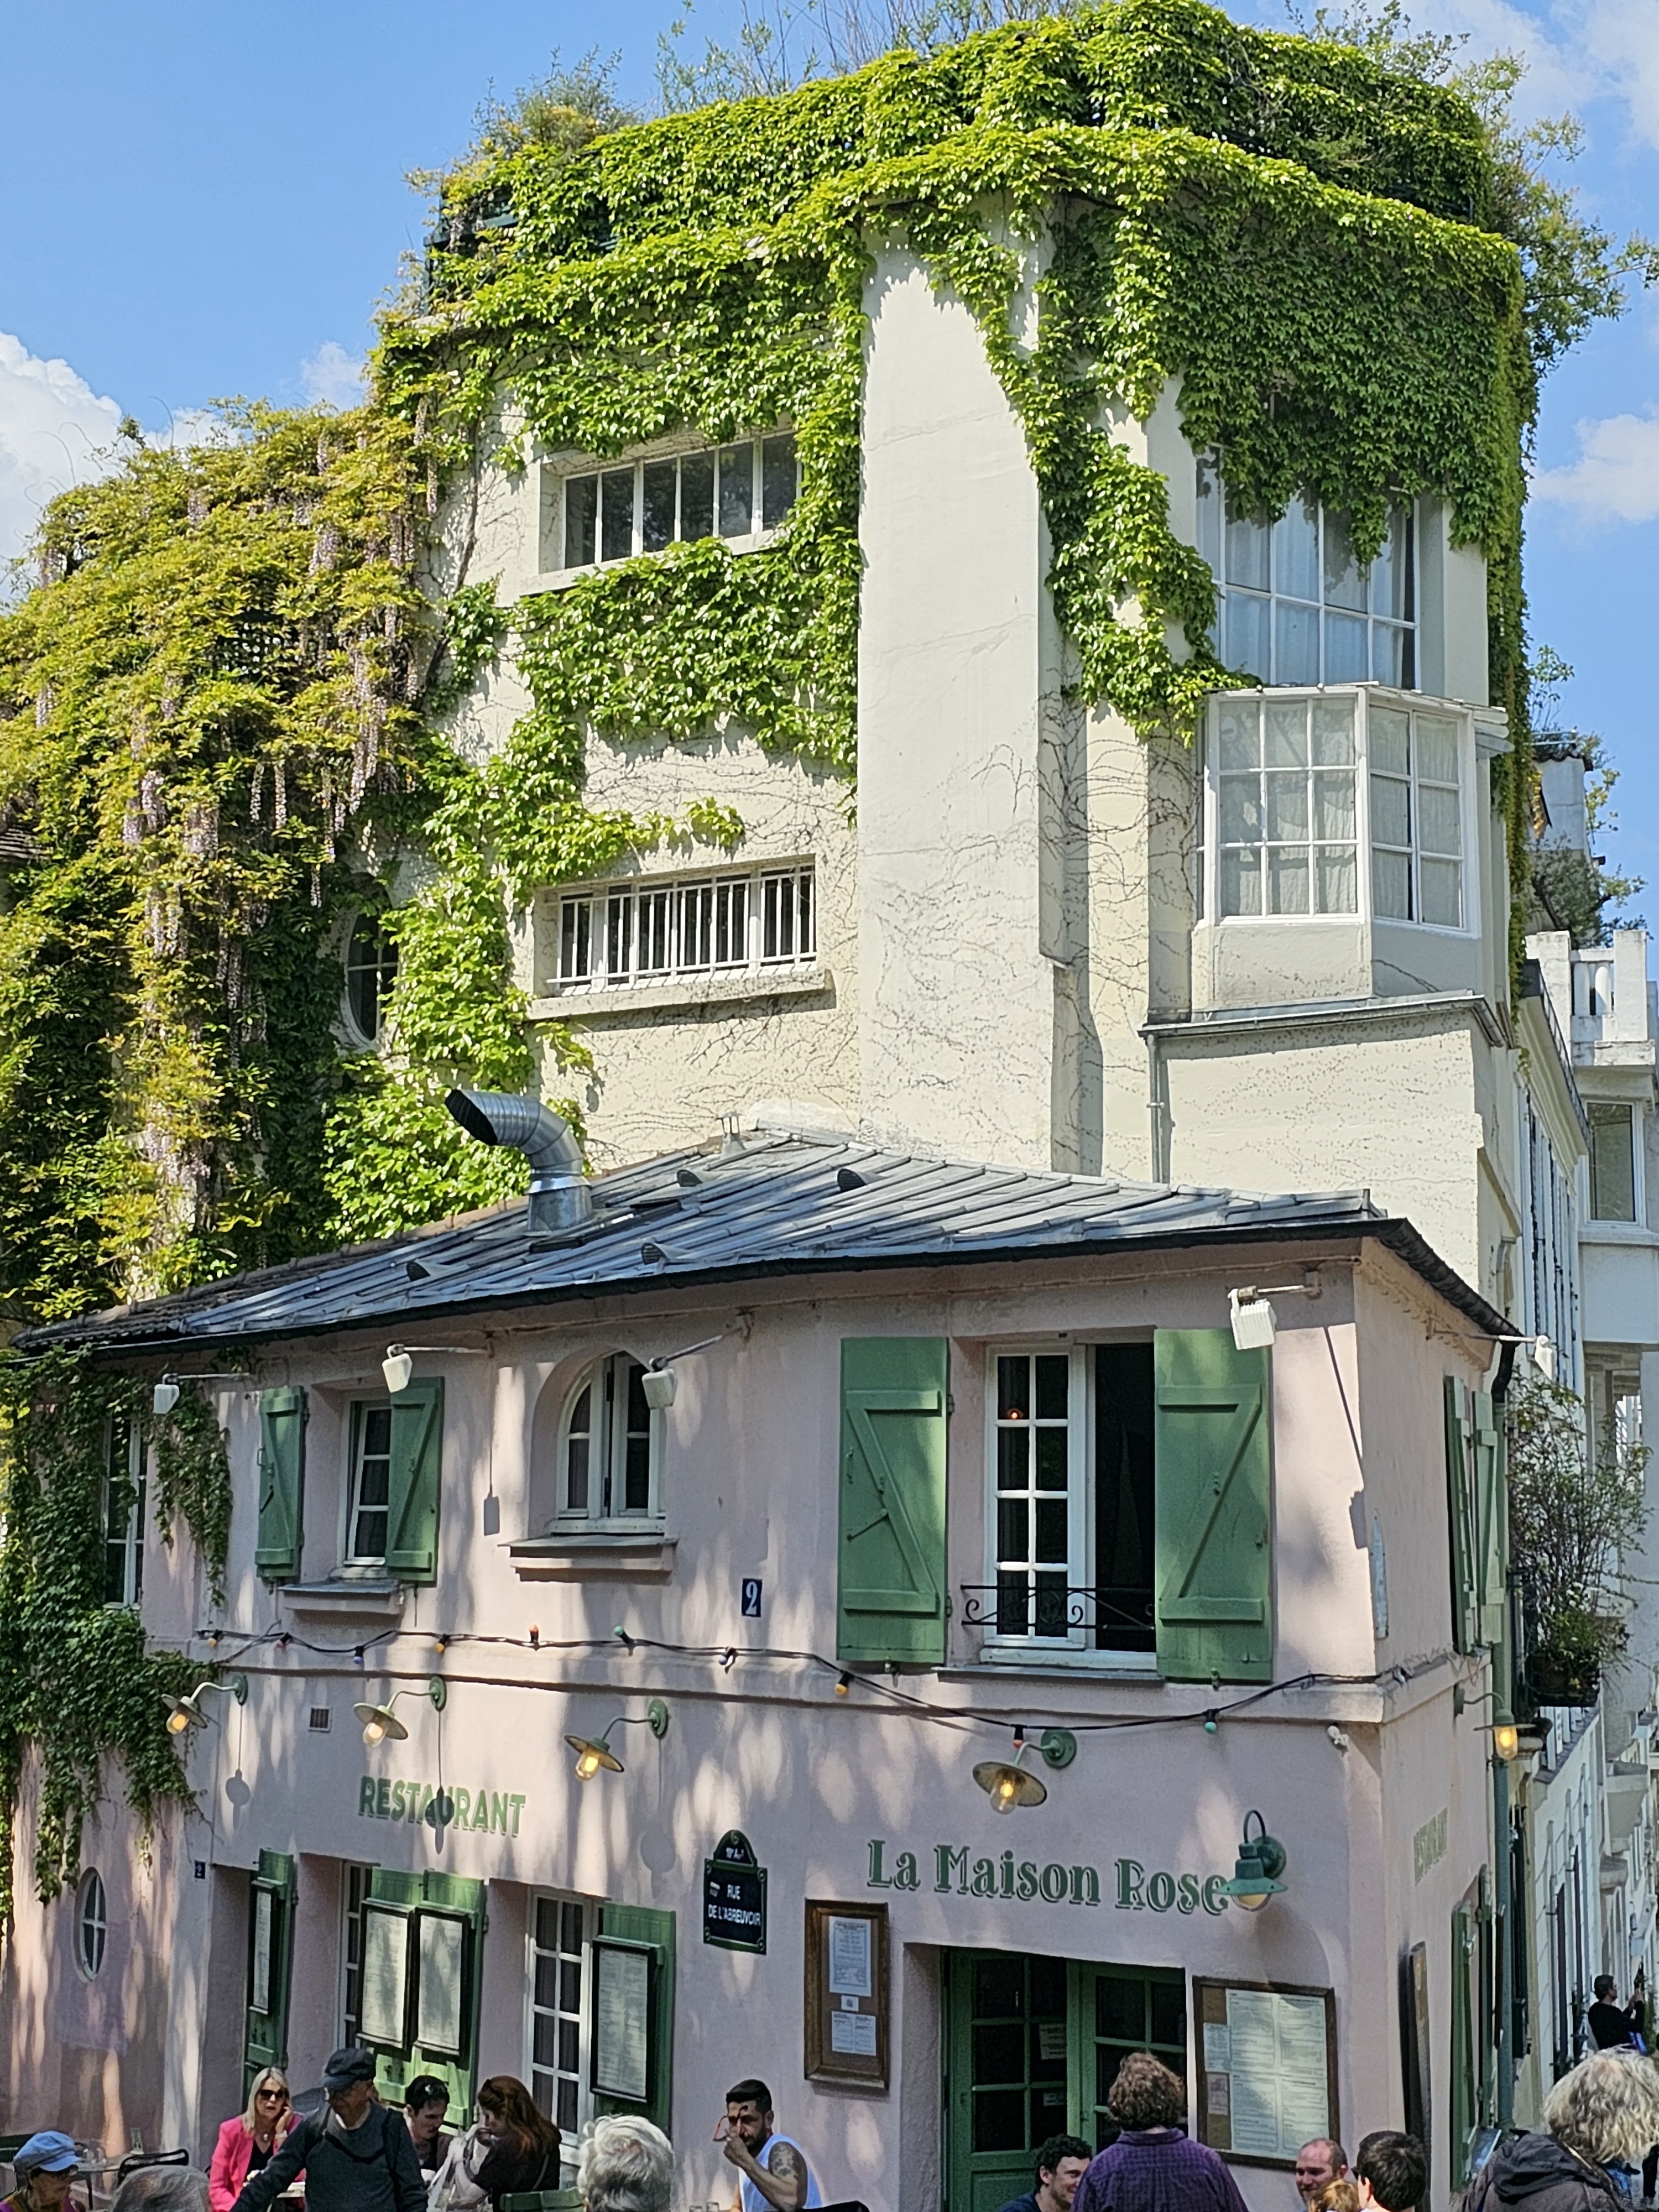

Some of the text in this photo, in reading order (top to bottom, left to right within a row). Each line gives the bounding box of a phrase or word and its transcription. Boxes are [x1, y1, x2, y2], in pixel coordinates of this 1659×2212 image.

[745, 1581, 758, 1615] 2
[358, 1775, 526, 1838] RESTAURANT
[727, 1884, 741, 1901] RUE
[867, 1839, 1229, 1916] La Maison Rose
[708, 1903, 717, 1919] DE
